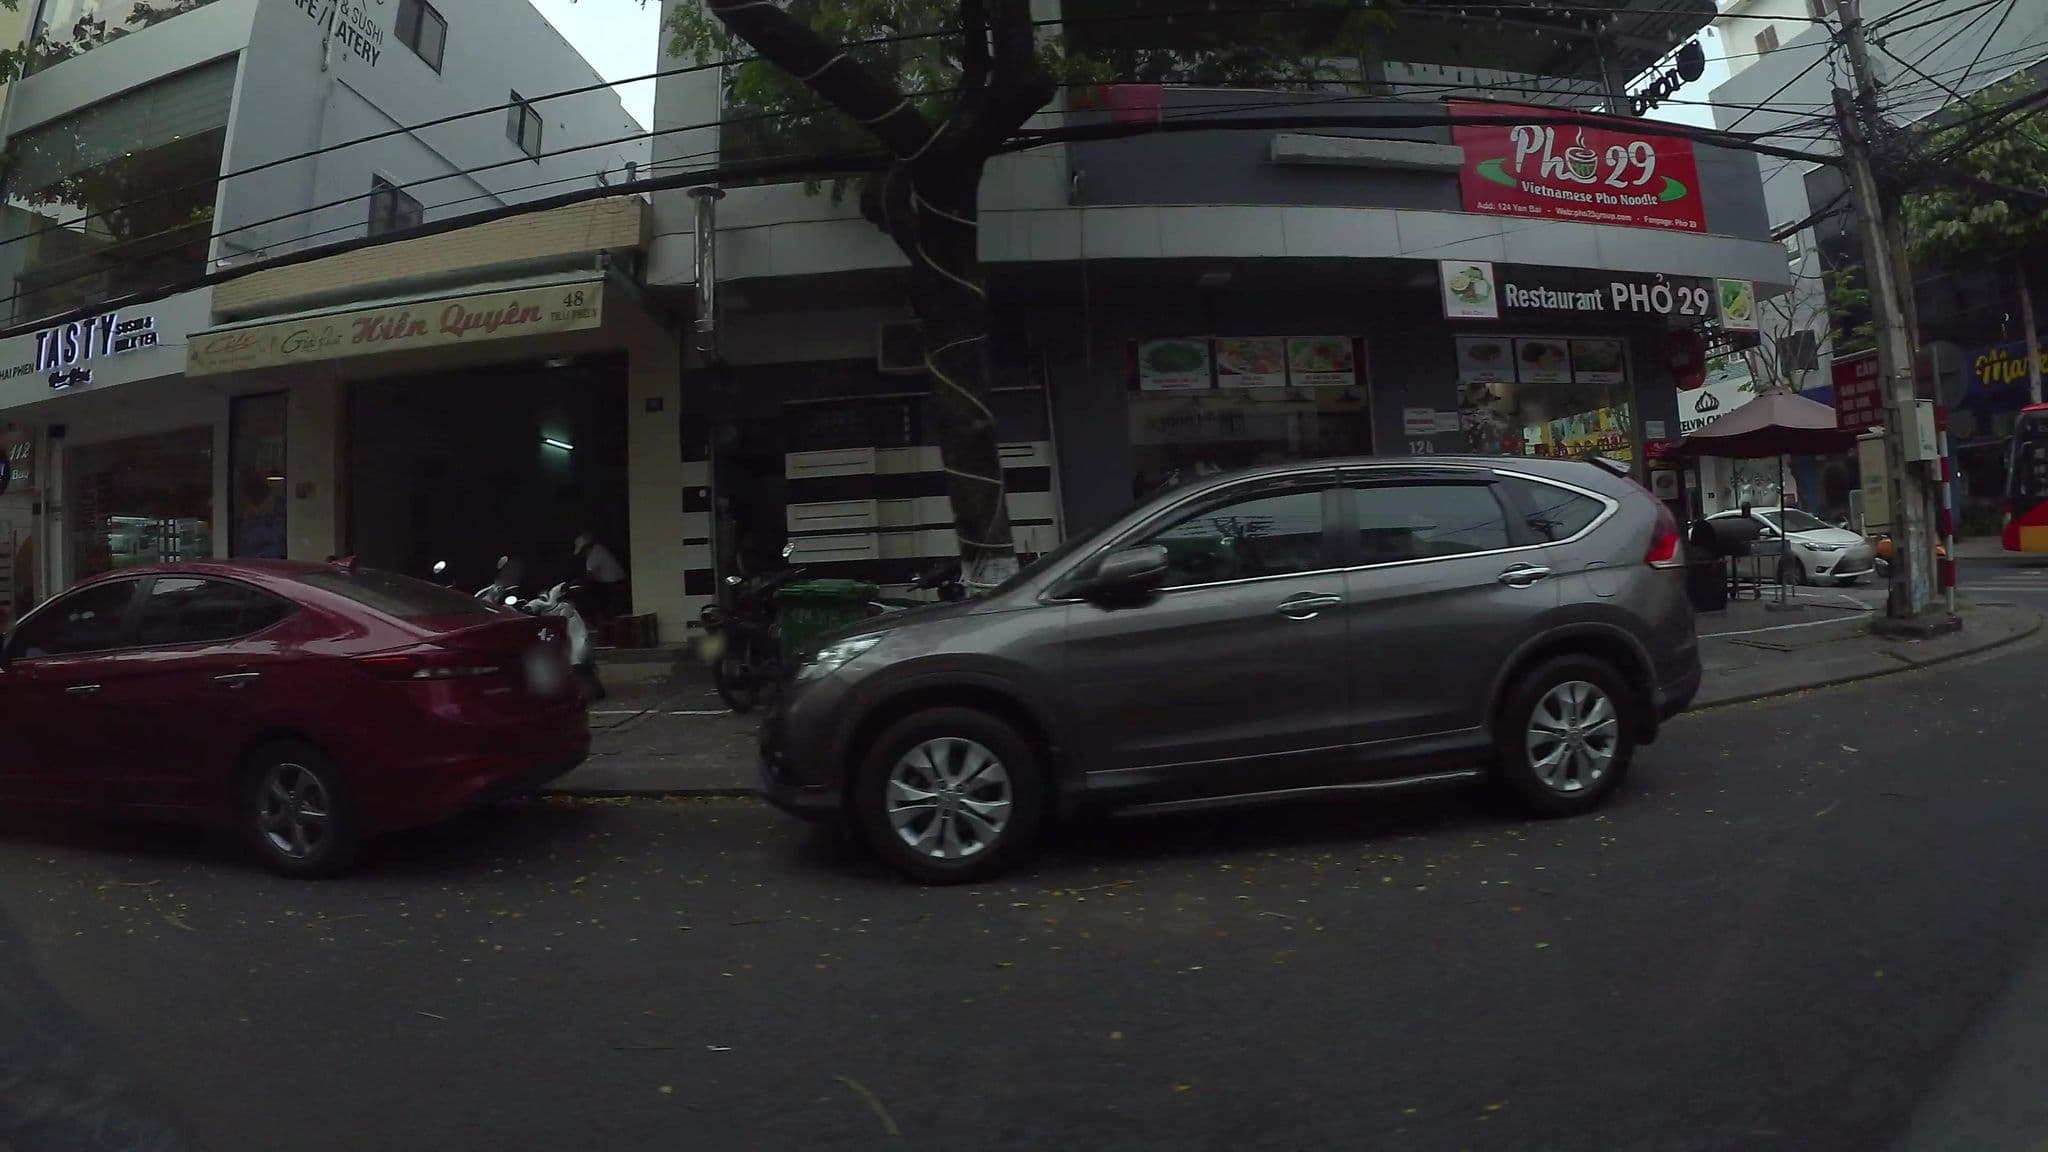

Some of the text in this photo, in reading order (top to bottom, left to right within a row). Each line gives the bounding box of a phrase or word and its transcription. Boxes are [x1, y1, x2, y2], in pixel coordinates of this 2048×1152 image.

[351, 7, 384, 45] SUSHI
[1604, 141, 1656, 189] 29
[1521, 180, 1658, 206] Vietnamese Pho Noodle
[563, 290, 584, 307] 48
[1504, 273, 1710, 316] Restaurant PHỞ 29
[35, 313, 118, 372] TASTY
